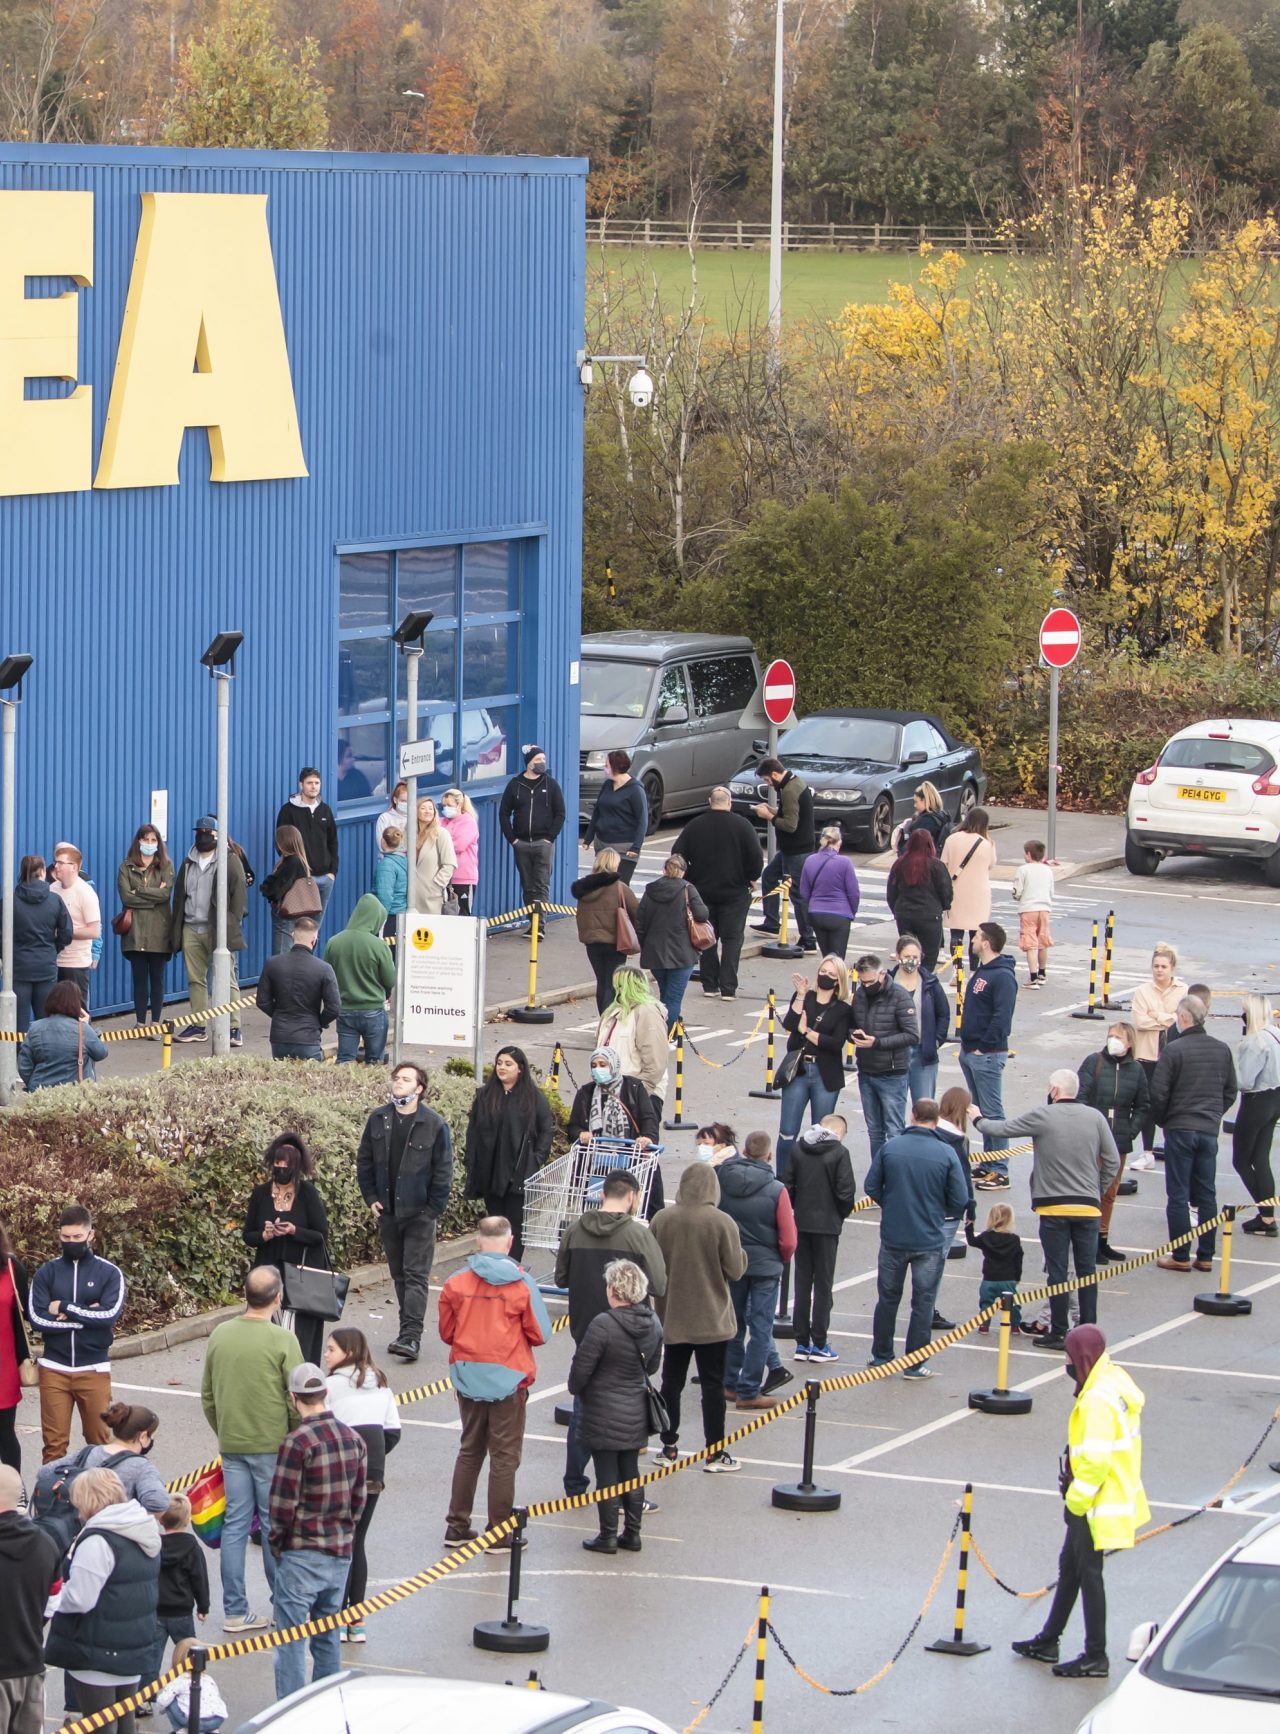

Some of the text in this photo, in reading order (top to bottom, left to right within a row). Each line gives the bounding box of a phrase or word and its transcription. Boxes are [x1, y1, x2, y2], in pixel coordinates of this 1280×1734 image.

[1182, 788, 1221, 800] PE14 GYG
[410, 1004, 466, 1017] 10 minutes
